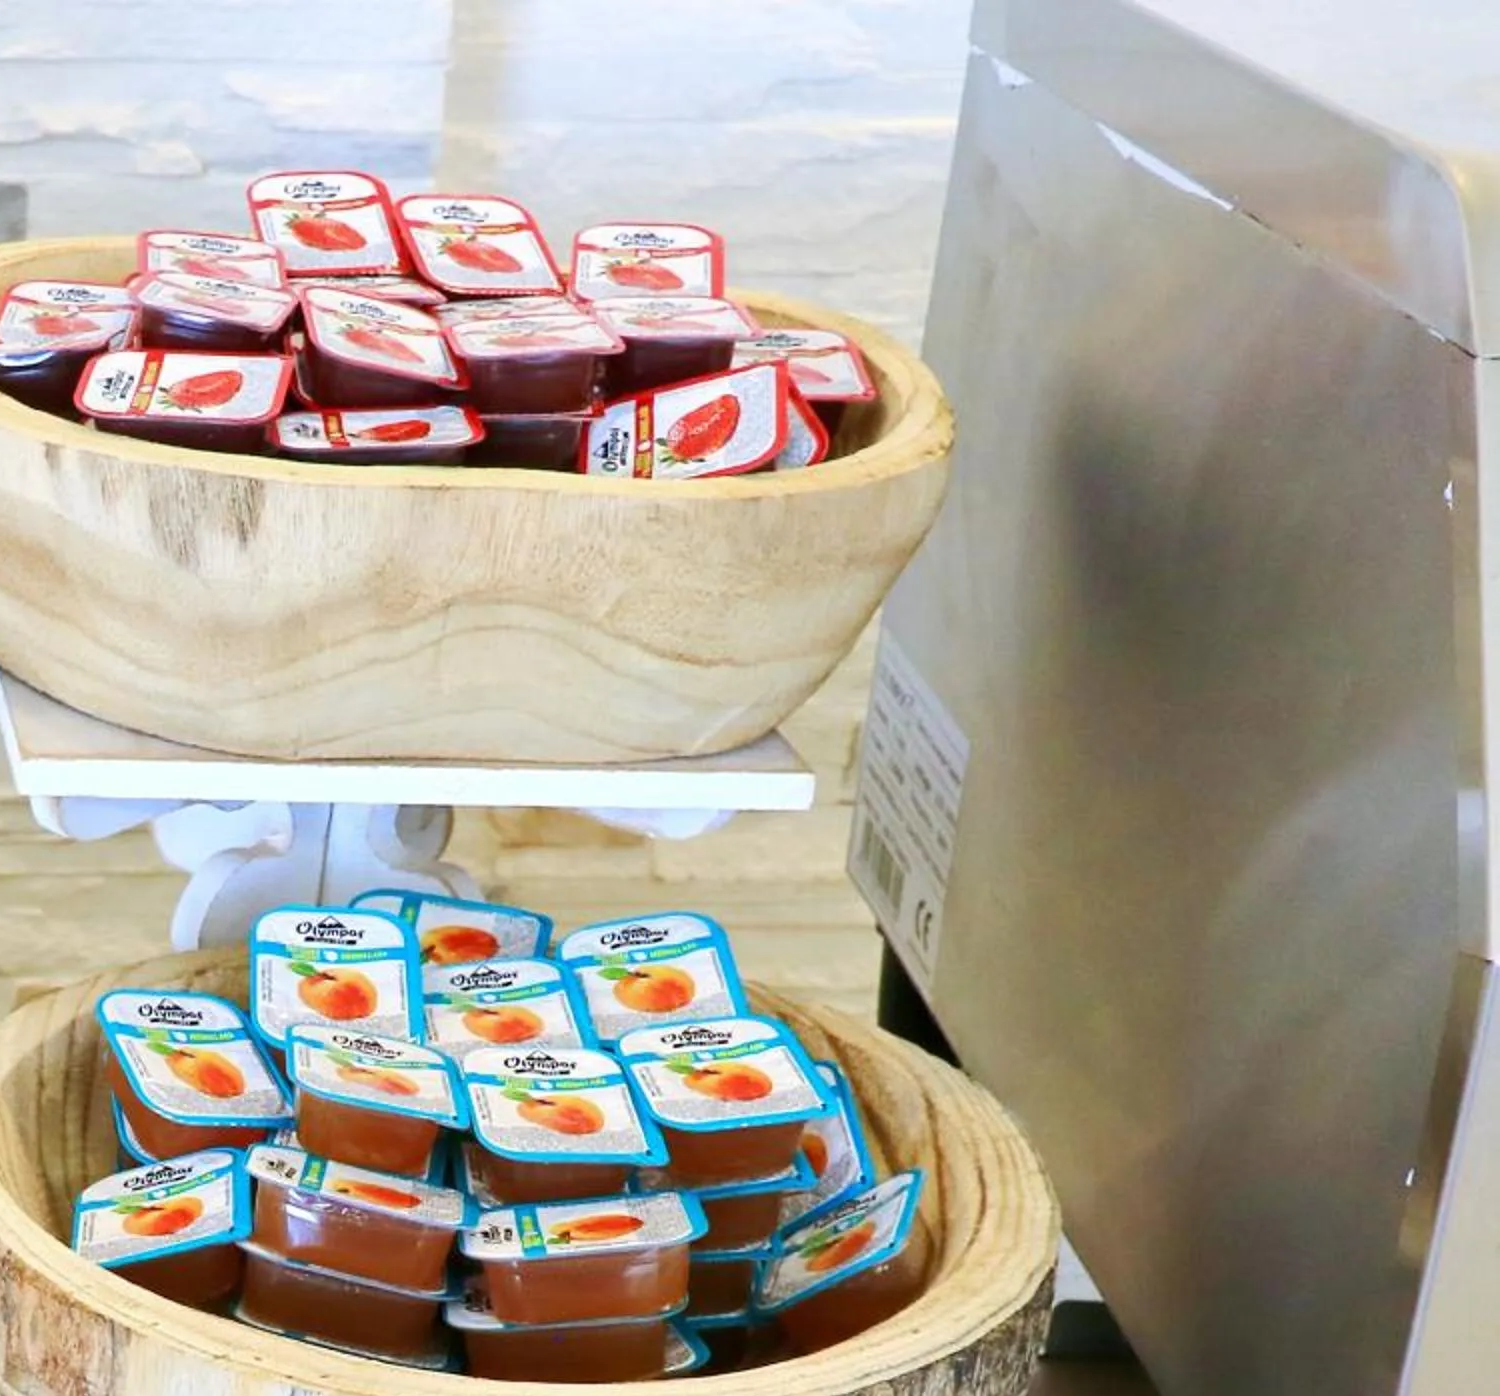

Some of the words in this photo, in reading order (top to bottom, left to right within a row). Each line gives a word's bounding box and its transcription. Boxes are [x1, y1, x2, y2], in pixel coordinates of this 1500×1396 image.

[295, 920, 365, 941] Olympos
[138, 1003, 203, 1022] Olympos
[503, 1055, 578, 1076] Olympos
